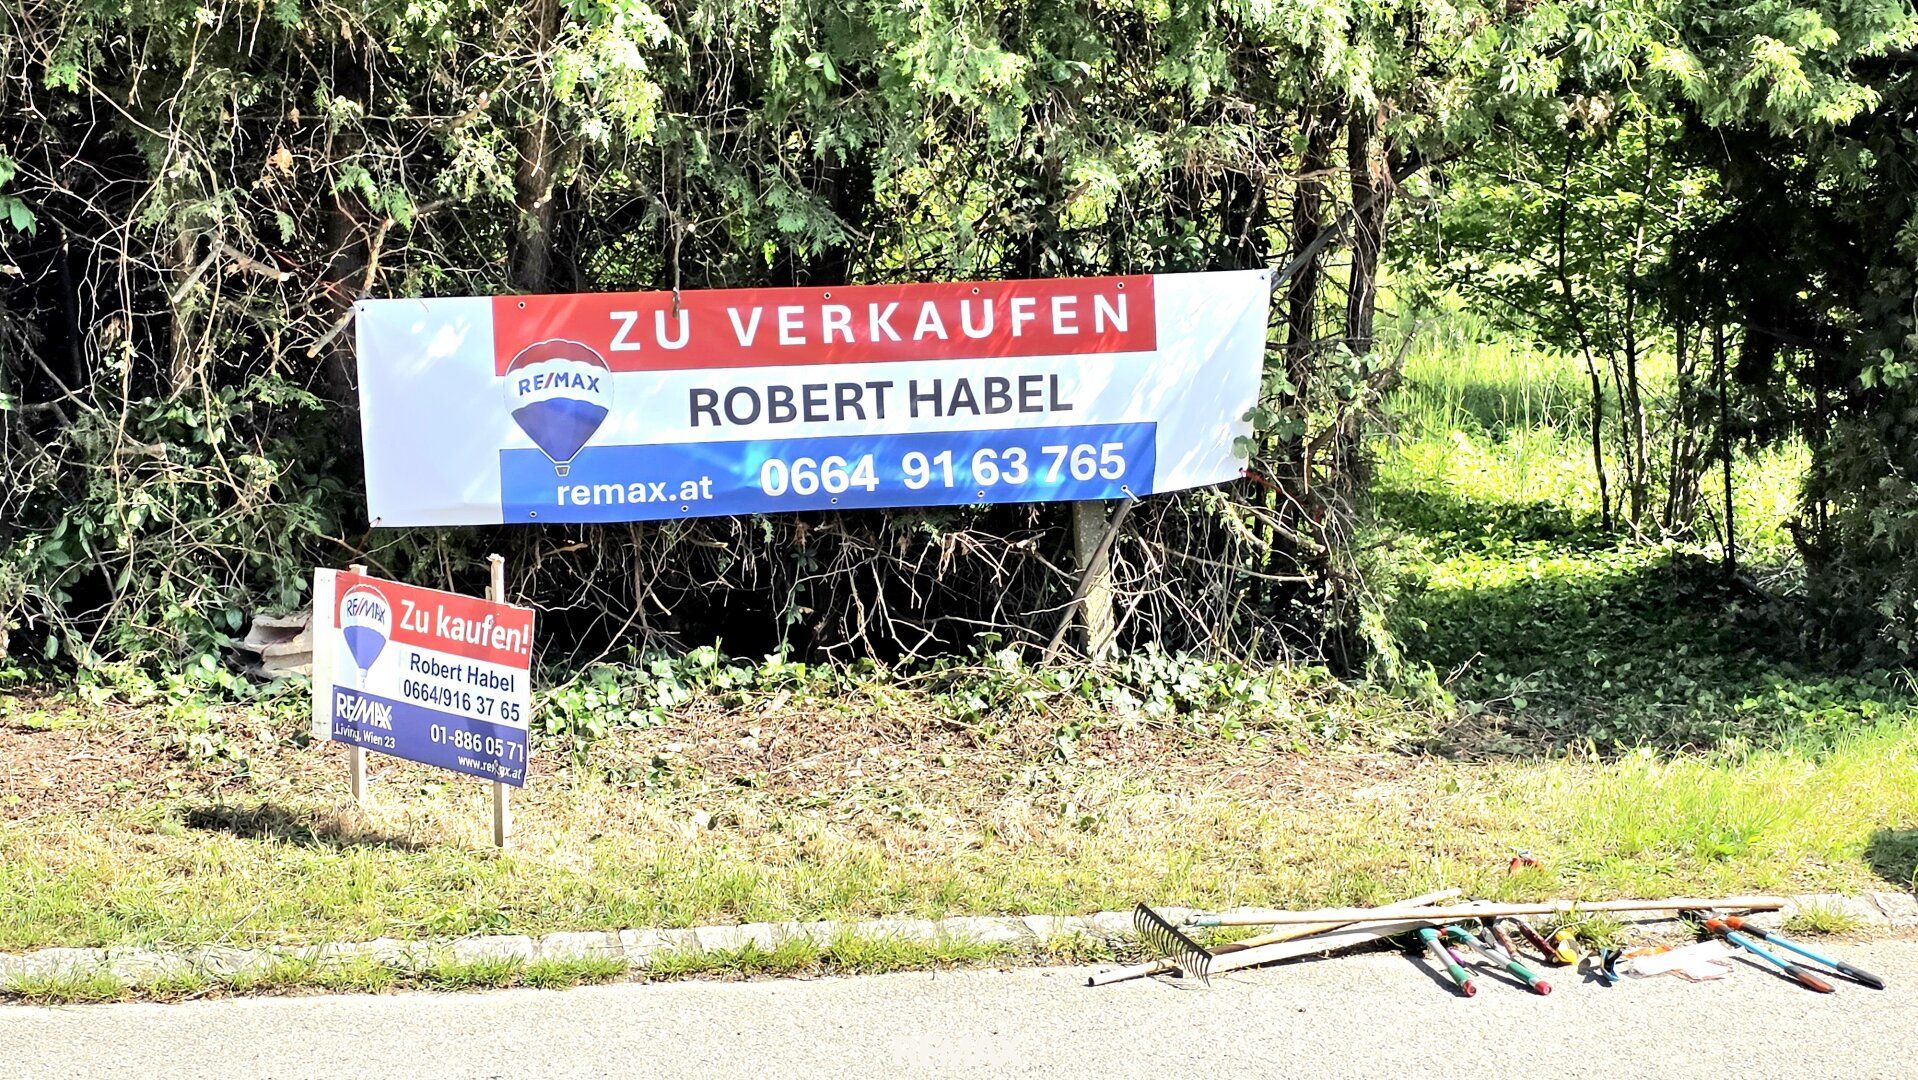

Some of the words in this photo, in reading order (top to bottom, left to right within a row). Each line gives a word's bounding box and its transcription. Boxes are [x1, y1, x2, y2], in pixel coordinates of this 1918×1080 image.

[609, 309, 690, 351] ZU
[727, 293, 1129, 347] VERKAUFEN
[518, 371, 600, 396] RE/MAX
[689, 380, 893, 427] ROBERT
[908, 374, 1073, 418] HABEL
[760, 454, 880, 497] 0664
[901, 450, 954, 490] 91
[971, 447, 1028, 486] 63
[1041, 442, 1126, 482] 765
[557, 475, 713, 506] remax.at
[346, 598, 386, 626] RE/MAX
[400, 599, 429, 634] Zu
[436, 605, 529, 654] kaufen!
[410, 653, 462, 682] Robert
[467, 665, 515, 693] Habel
[336, 692, 392, 731] RE/MAX
[403, 679, 471, 712] 0664/916
[476, 698, 495, 716] 37
[500, 702, 520, 722] 65
[334, 722, 362, 742] Living,
[363, 729, 383, 746] Wien
[384, 735, 396, 749] 23
[430, 724, 482, 753] 01-886
[485, 739, 504, 758] 05
[507, 741, 524, 763] 71
